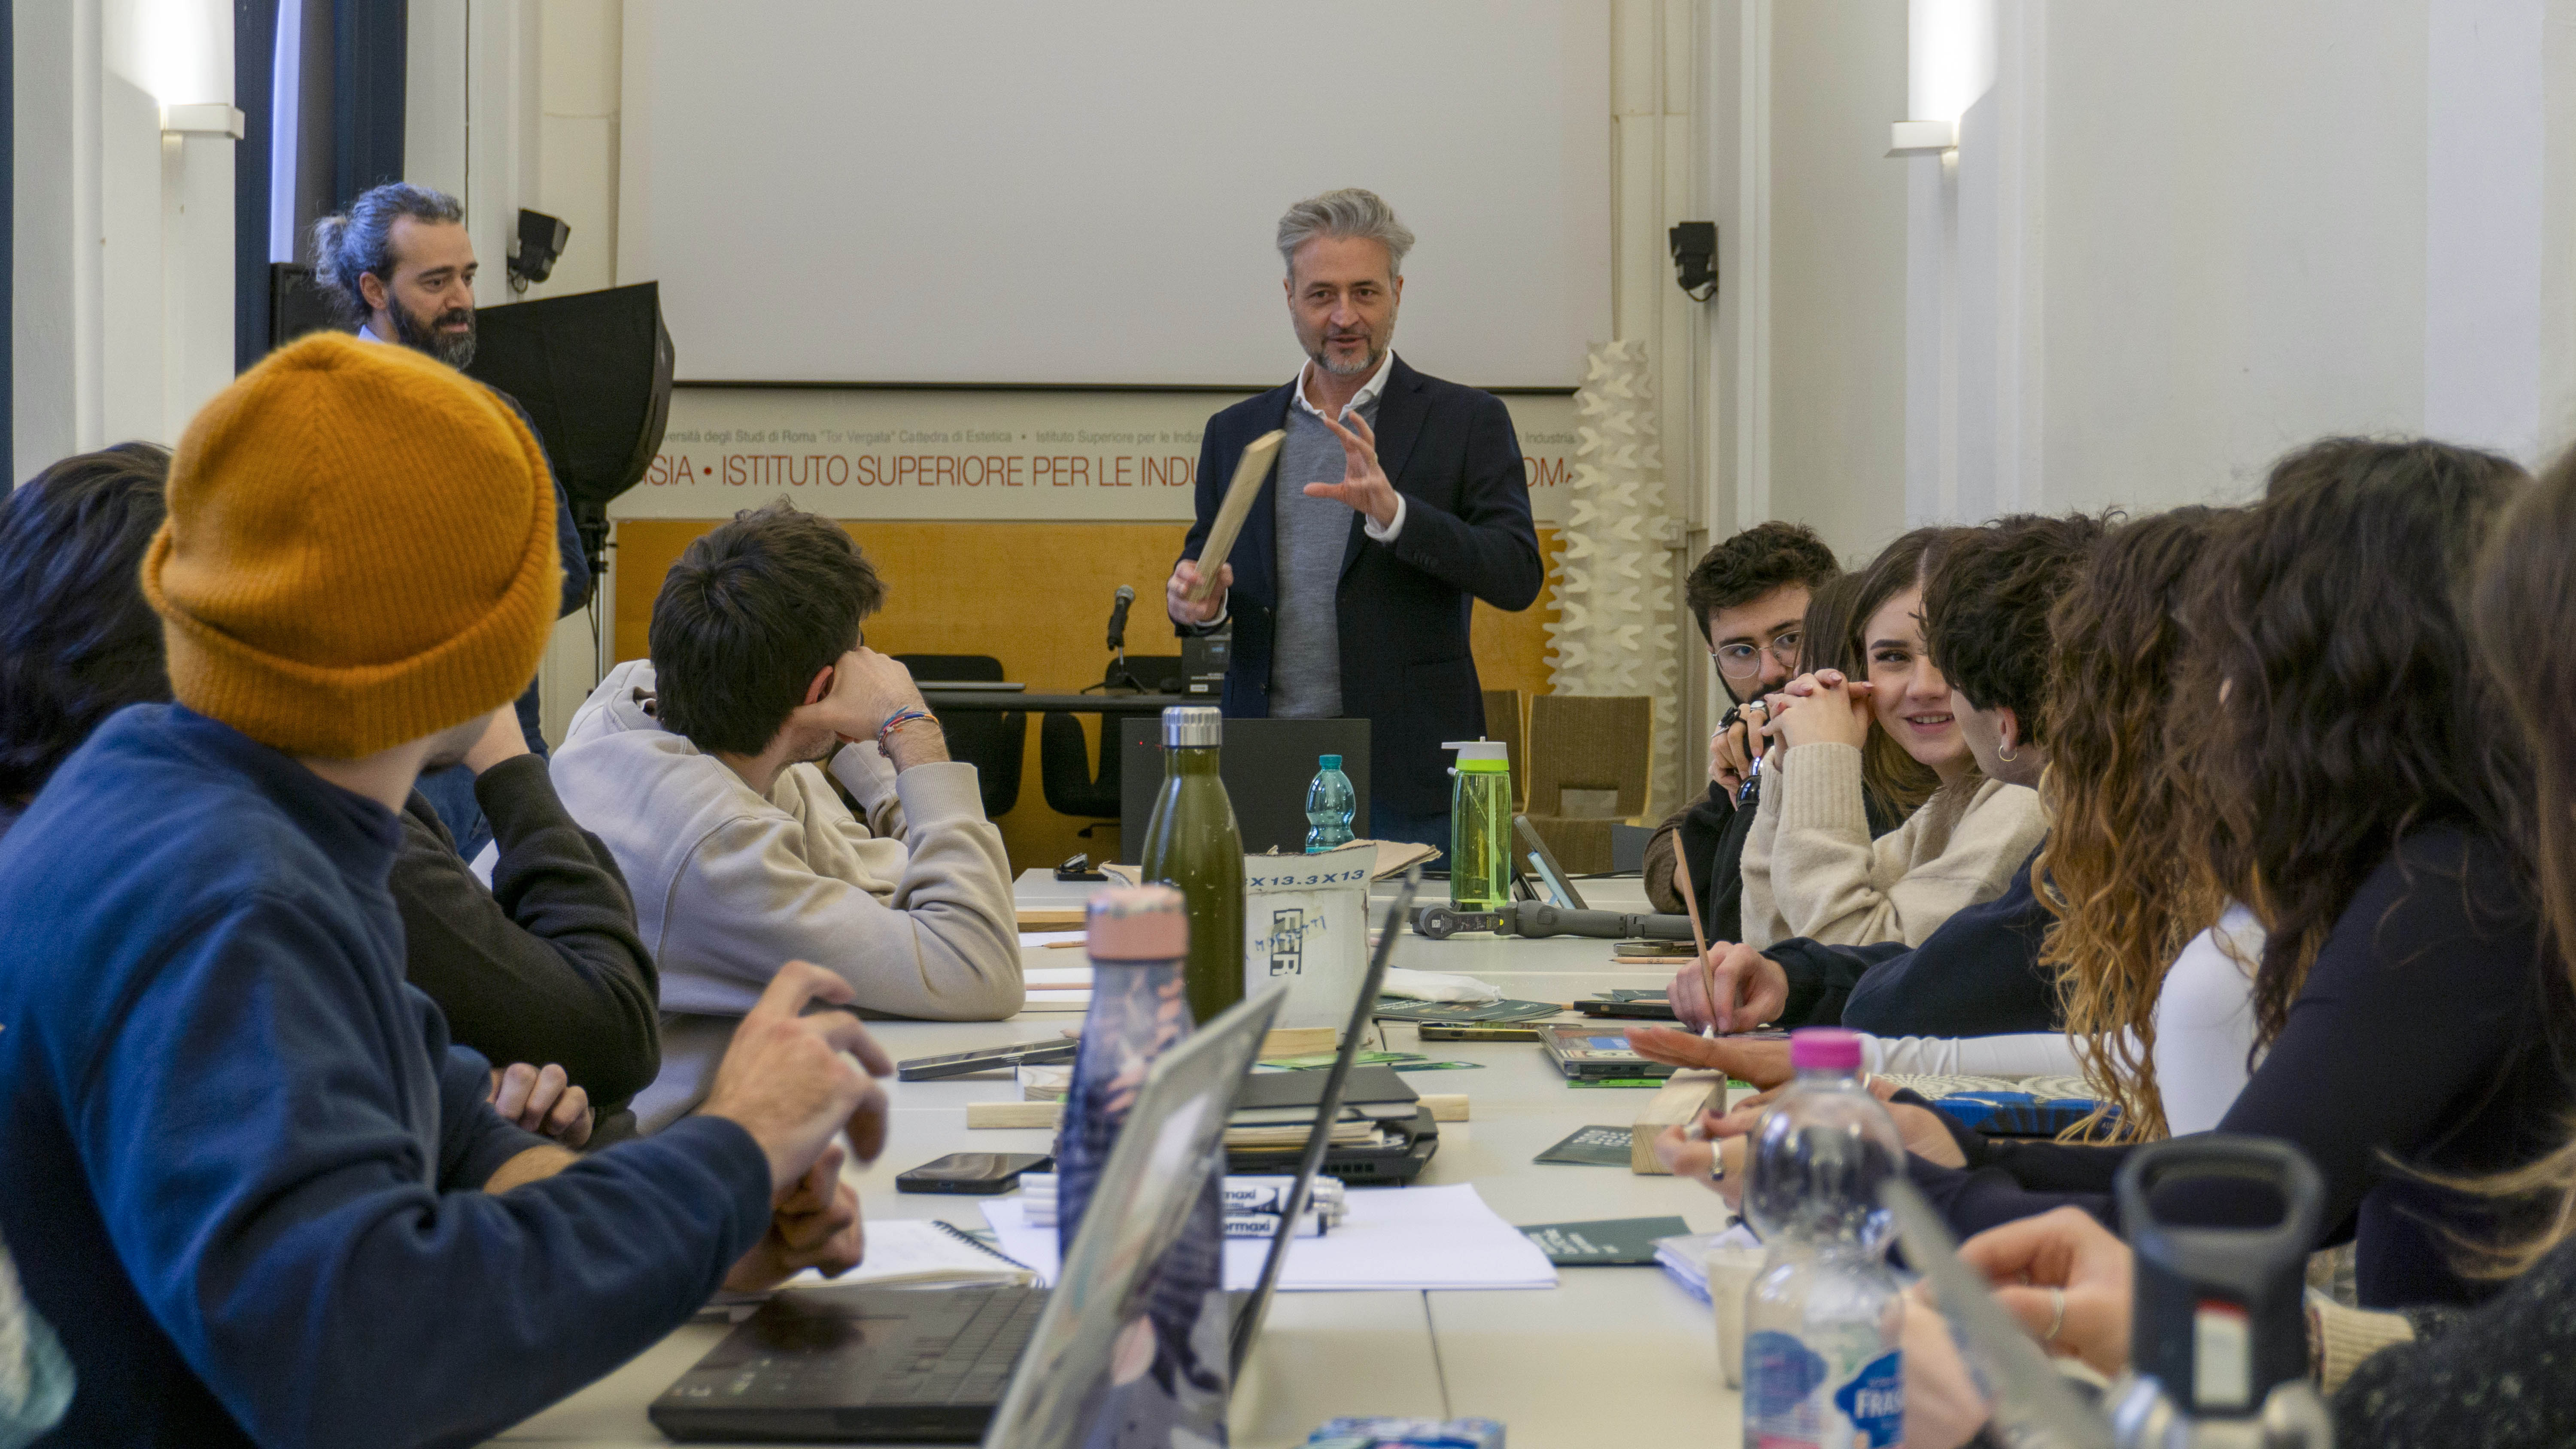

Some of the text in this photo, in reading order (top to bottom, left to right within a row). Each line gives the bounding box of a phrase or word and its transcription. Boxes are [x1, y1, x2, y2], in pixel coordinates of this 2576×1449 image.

[705, 430, 732, 446] degli
[735, 429, 765, 443] Studi
[769, 430, 778, 443] di
[782, 430, 817, 443] Roma
[847, 430, 896, 446] Vergata"
[899, 430, 949, 443] Cattedra
[952, 430, 962, 443] di
[966, 430, 1012, 443] Estetica
[1036, 430, 1075, 443] Istituto
[1078, 430, 1134, 445] Superiore
[1137, 433, 1155, 446] per
[1160, 430, 1170, 443] le
[722, 454, 849, 486] ISTITUTO
[857, 455, 1024, 486] SUPERIORE
[1033, 456, 1089, 486] PER
[1100, 456, 1132, 486] LE
[1522, 456, 1573, 487] OM
[1244, 870, 1364, 887] X13.3X13
